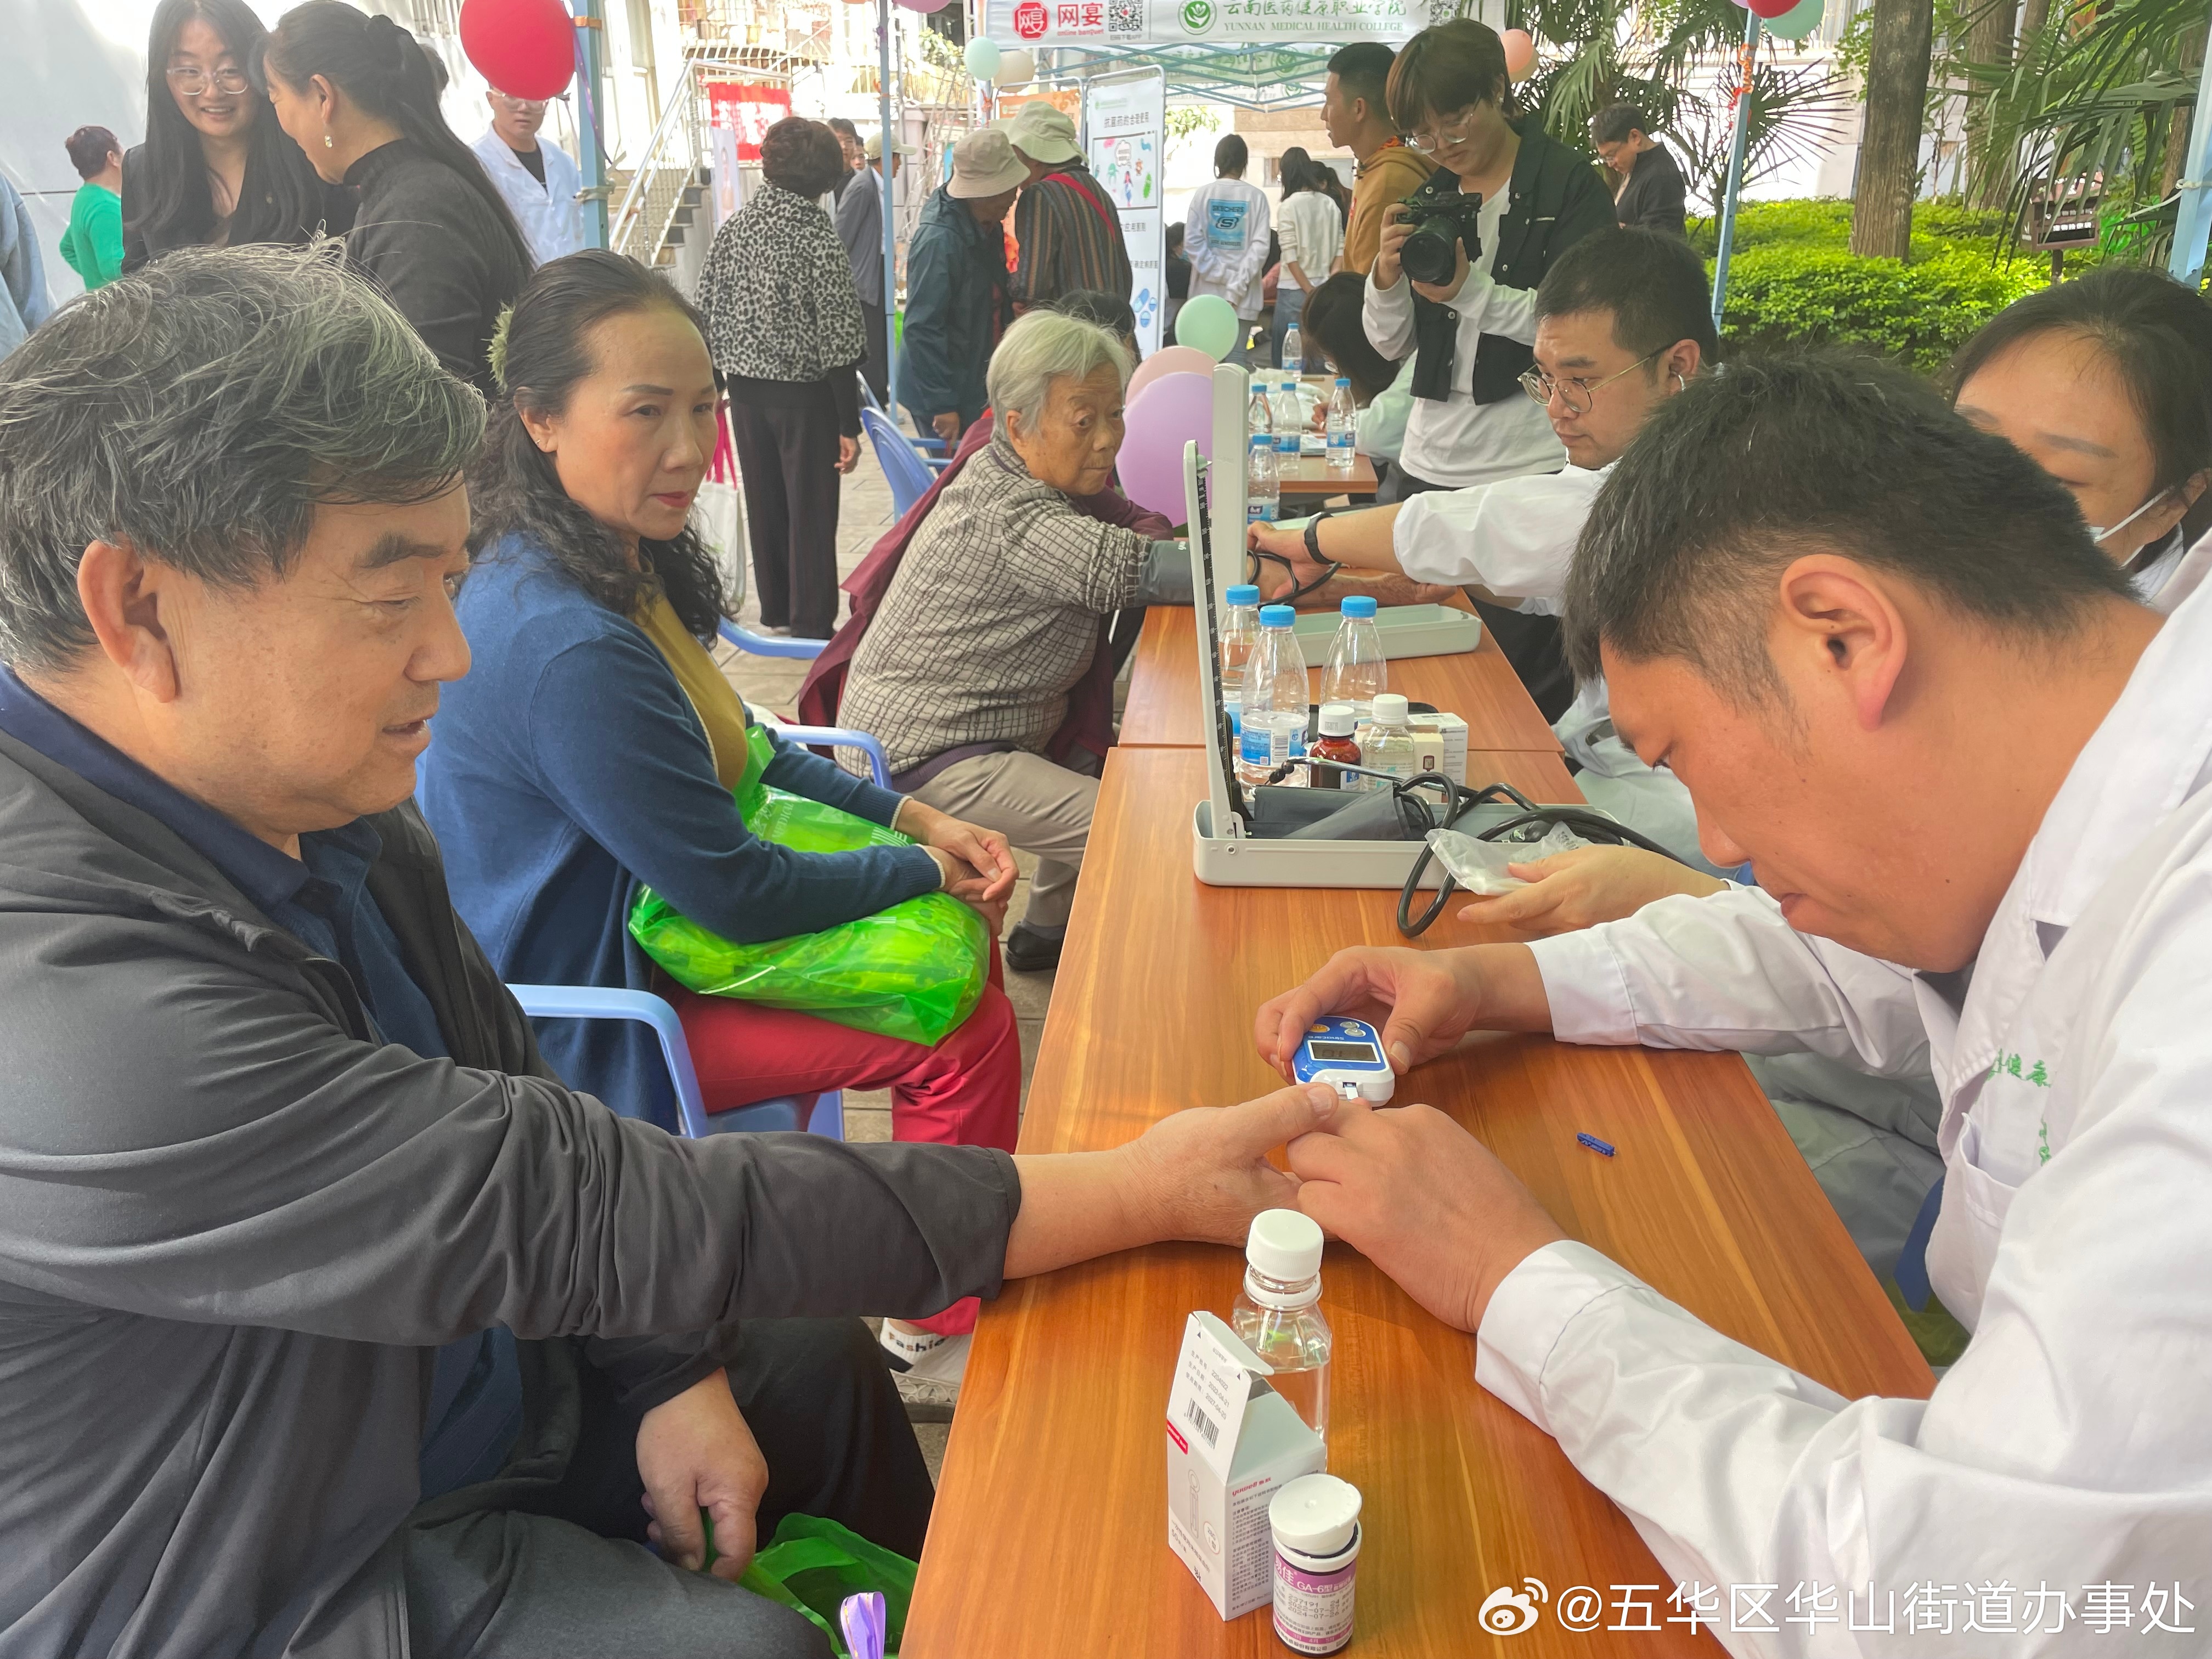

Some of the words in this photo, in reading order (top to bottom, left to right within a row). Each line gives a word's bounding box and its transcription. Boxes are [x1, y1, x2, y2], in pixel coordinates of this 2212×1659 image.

[1058, 3, 1103, 27] 网宴
[1224, 22, 1265, 31] YUNNAN
[1271, 22, 1315, 31] MEDICAL
[1318, 22, 1356, 31] HEALTH
[1359, 22, 1404, 31] COLLEGE
[1208, 1381, 1229, 1408] 2022-04-21
[1232, 1481, 1258, 1497] yuwell
[1297, 1581, 1333, 1593] GA-6型
[1288, 1600, 1340, 1613] 2022-07-27
[1288, 1607, 1340, 1619] 2024-07-26
